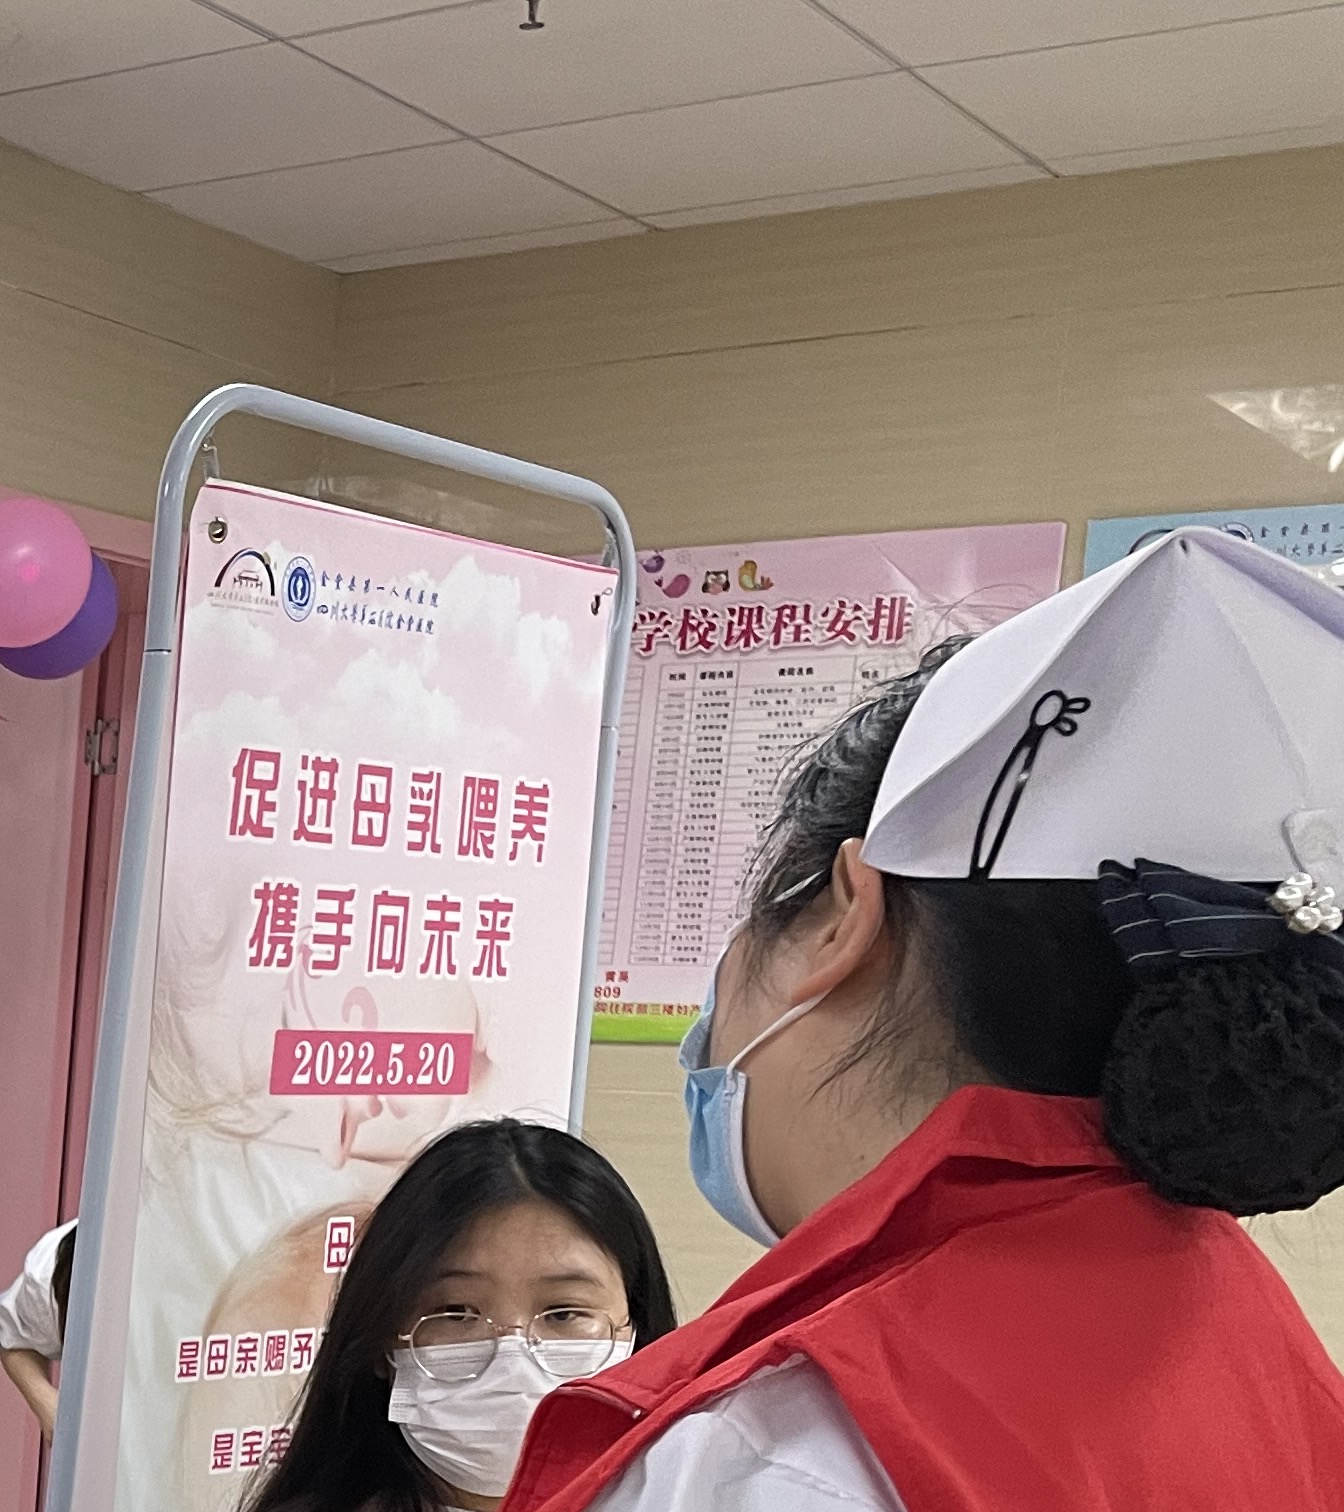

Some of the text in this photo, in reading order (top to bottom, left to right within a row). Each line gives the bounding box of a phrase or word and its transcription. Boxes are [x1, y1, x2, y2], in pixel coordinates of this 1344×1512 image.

[632, 597, 911, 653] 学校课程安排
[229, 748, 550, 862] 促进母乳喂养
[248, 882, 513, 978] 携手向未来
[291, 1040, 455, 1086] 2022.5.20
[177, 1333, 314, 1379] 是母亲赐予
